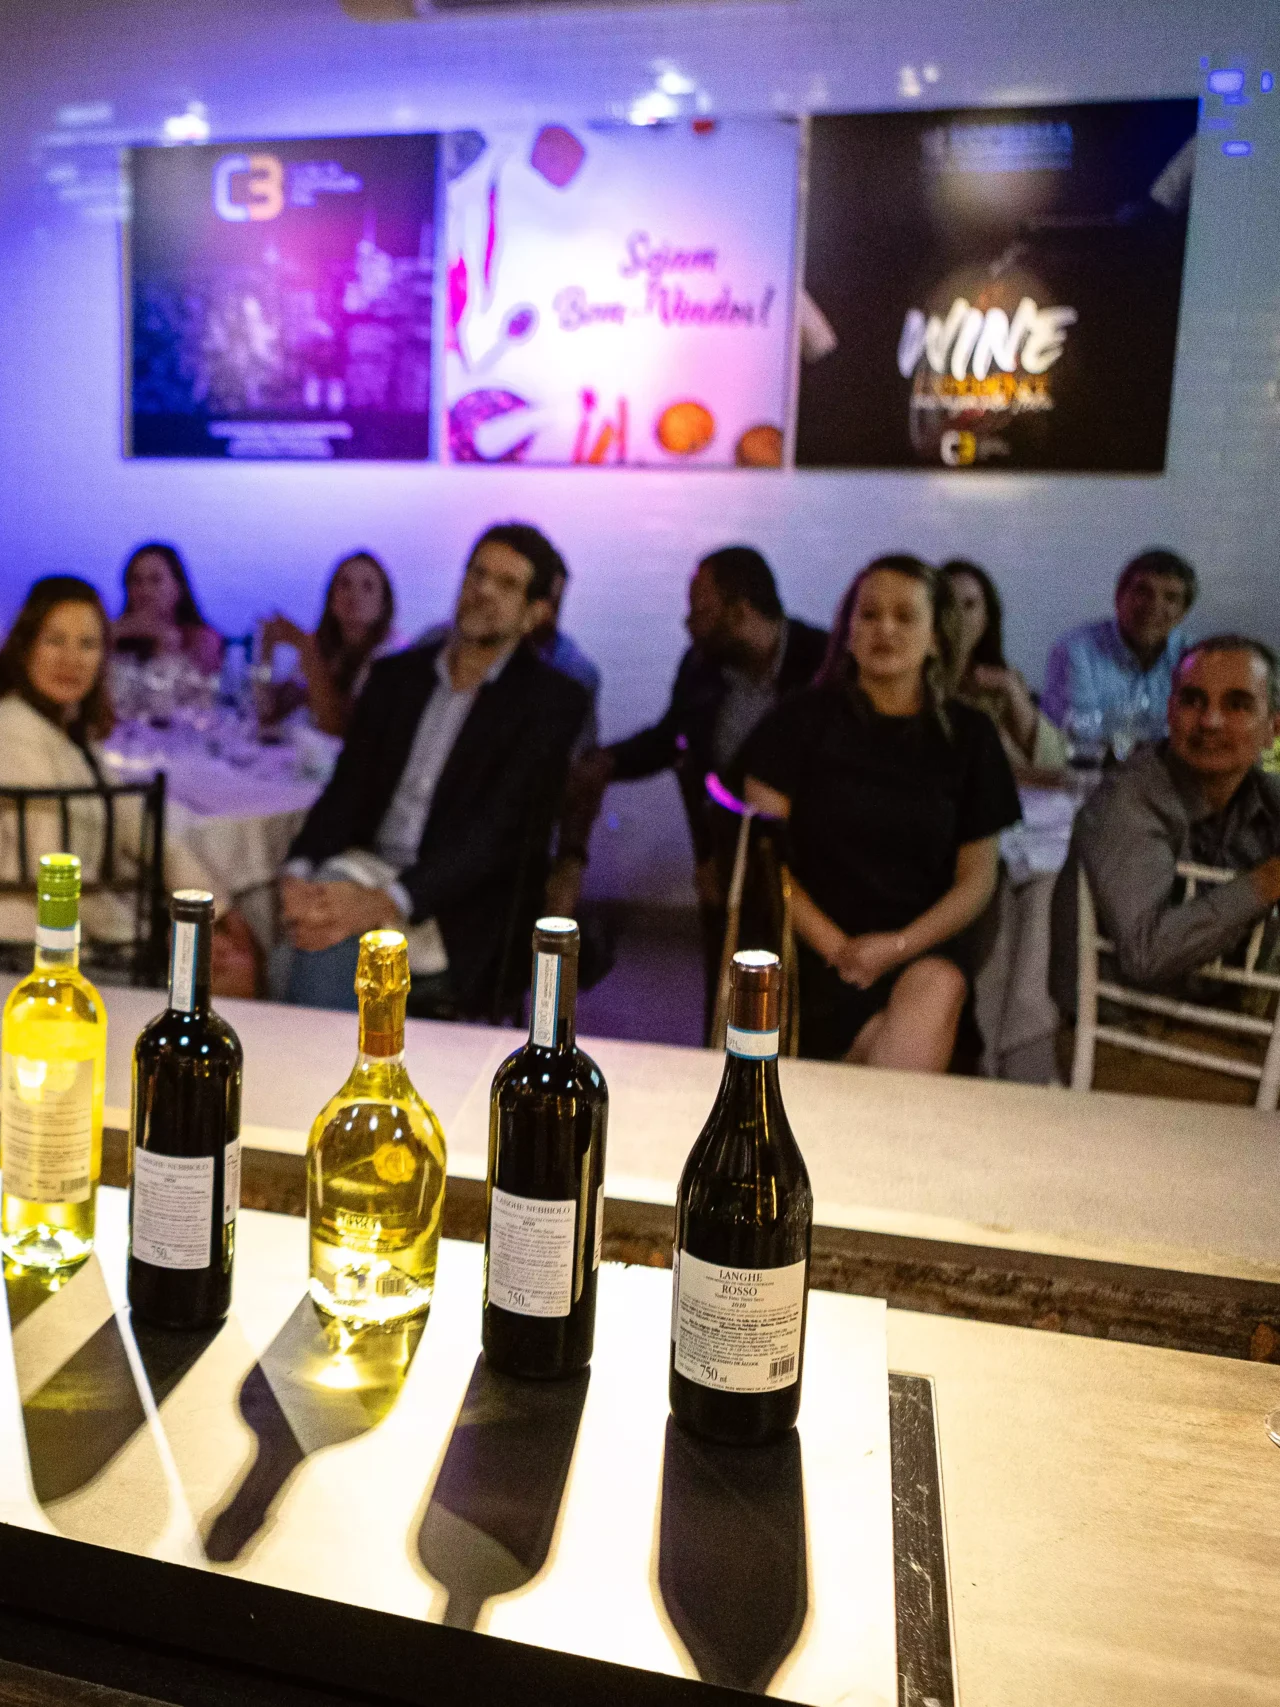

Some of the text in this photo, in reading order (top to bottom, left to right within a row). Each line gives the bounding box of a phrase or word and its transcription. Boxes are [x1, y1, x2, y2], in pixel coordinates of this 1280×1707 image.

[213, 154, 285, 222] C3
[897, 296, 1078, 381] WINE
[526, 1205, 571, 1214] NEBBIOLO
[719, 1269, 763, 1282] LANGHE
[507, 1290, 524, 1307] 750
[722, 1284, 757, 1296] ROSSO
[699, 1364, 718, 1381] 750
